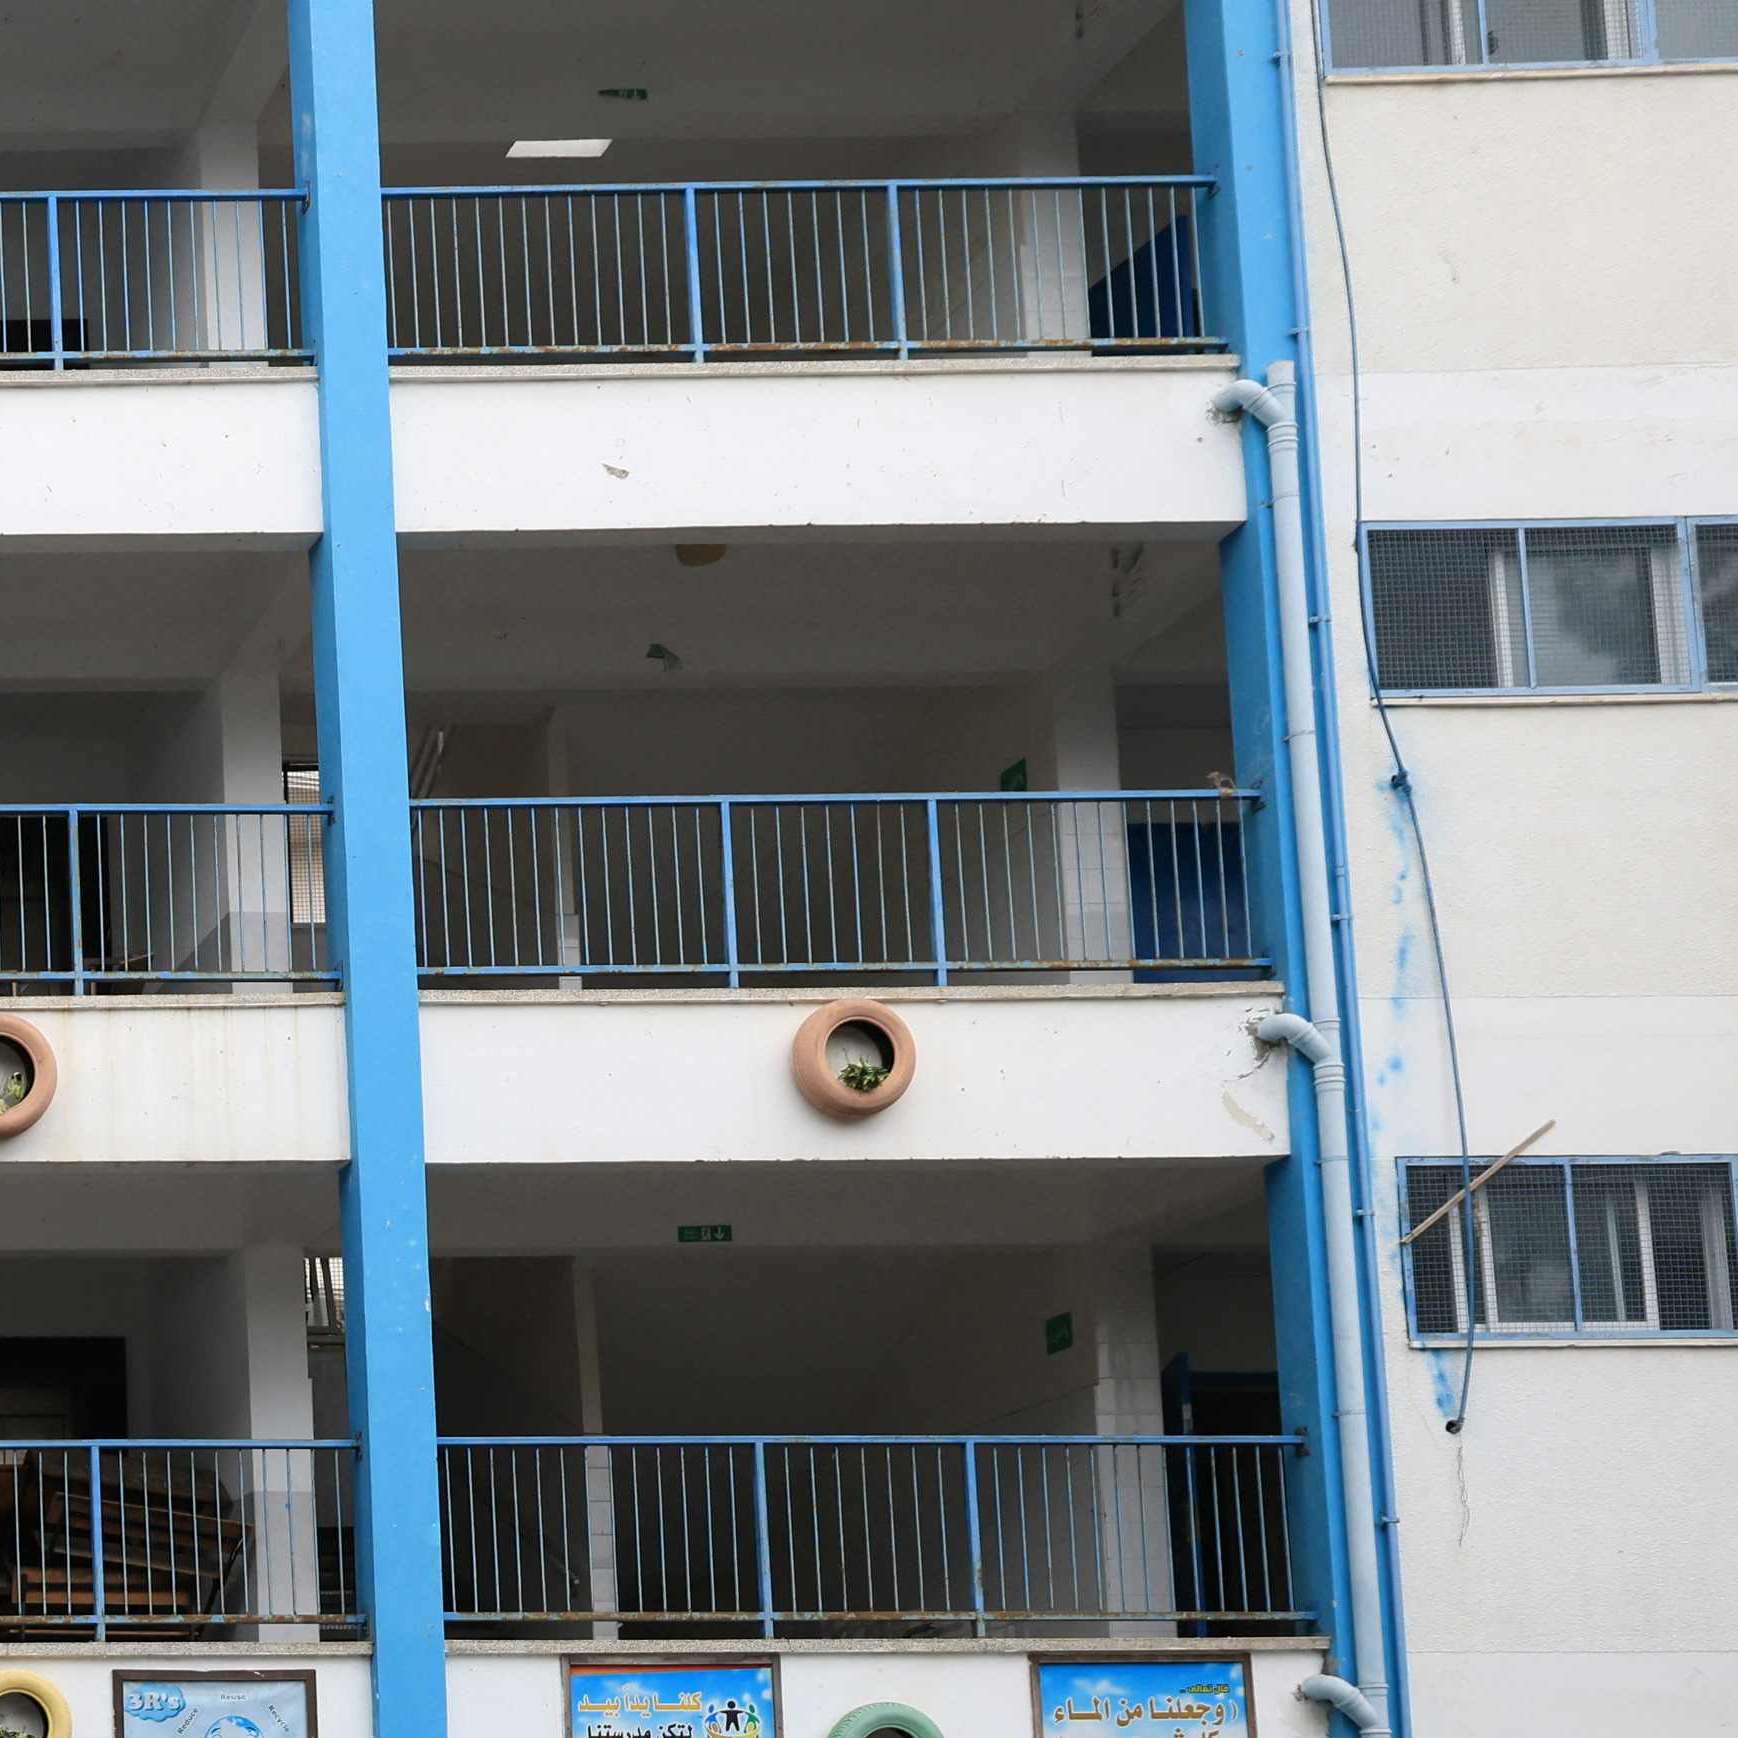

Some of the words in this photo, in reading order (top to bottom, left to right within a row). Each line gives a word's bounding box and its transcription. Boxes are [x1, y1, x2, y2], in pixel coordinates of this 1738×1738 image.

[578, 1694, 622, 1718] بيد
[652, 1691, 703, 1712] كلنا
[1053, 1696, 1112, 1724] الماء
[1116, 1699, 1143, 1727] من
[1150, 1696, 1224, 1726] وجعلنا
[176, 1706, 200, 1736] Reduce
